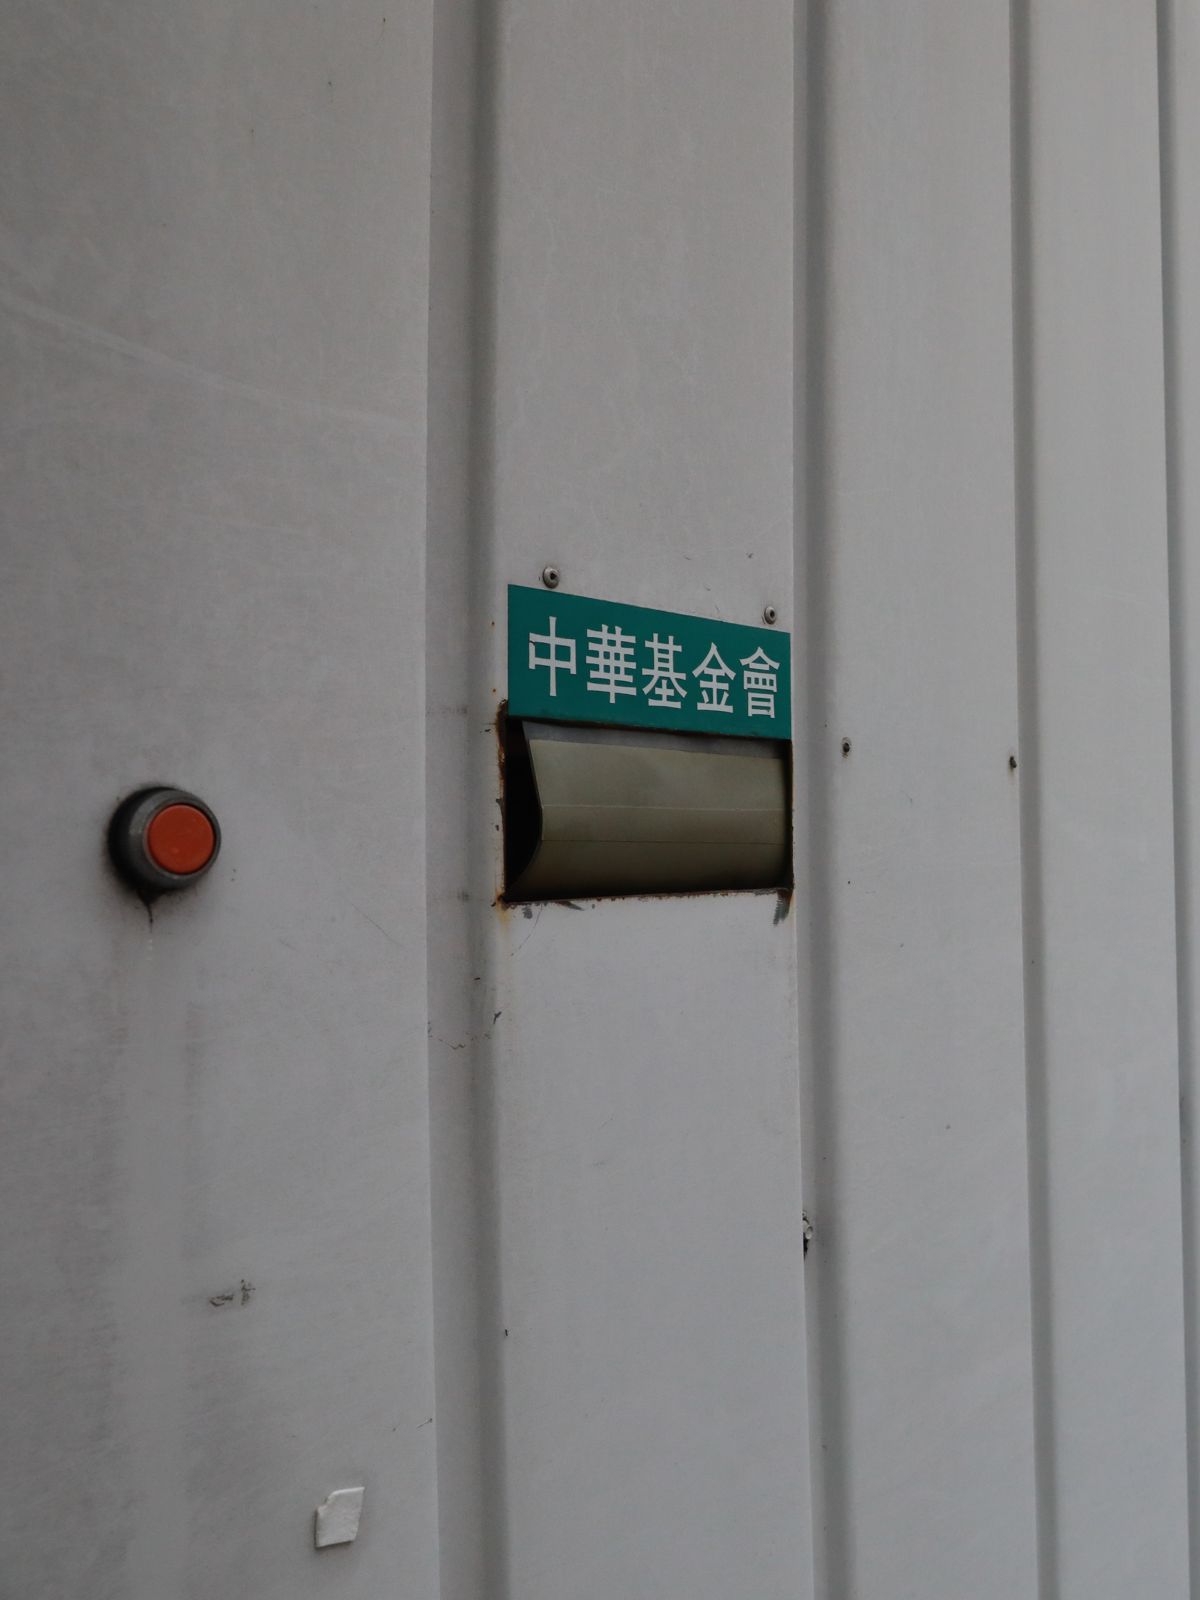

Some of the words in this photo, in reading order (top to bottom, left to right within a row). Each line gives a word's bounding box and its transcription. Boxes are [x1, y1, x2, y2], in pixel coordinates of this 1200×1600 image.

[528, 616, 780, 719] 中華基金會
